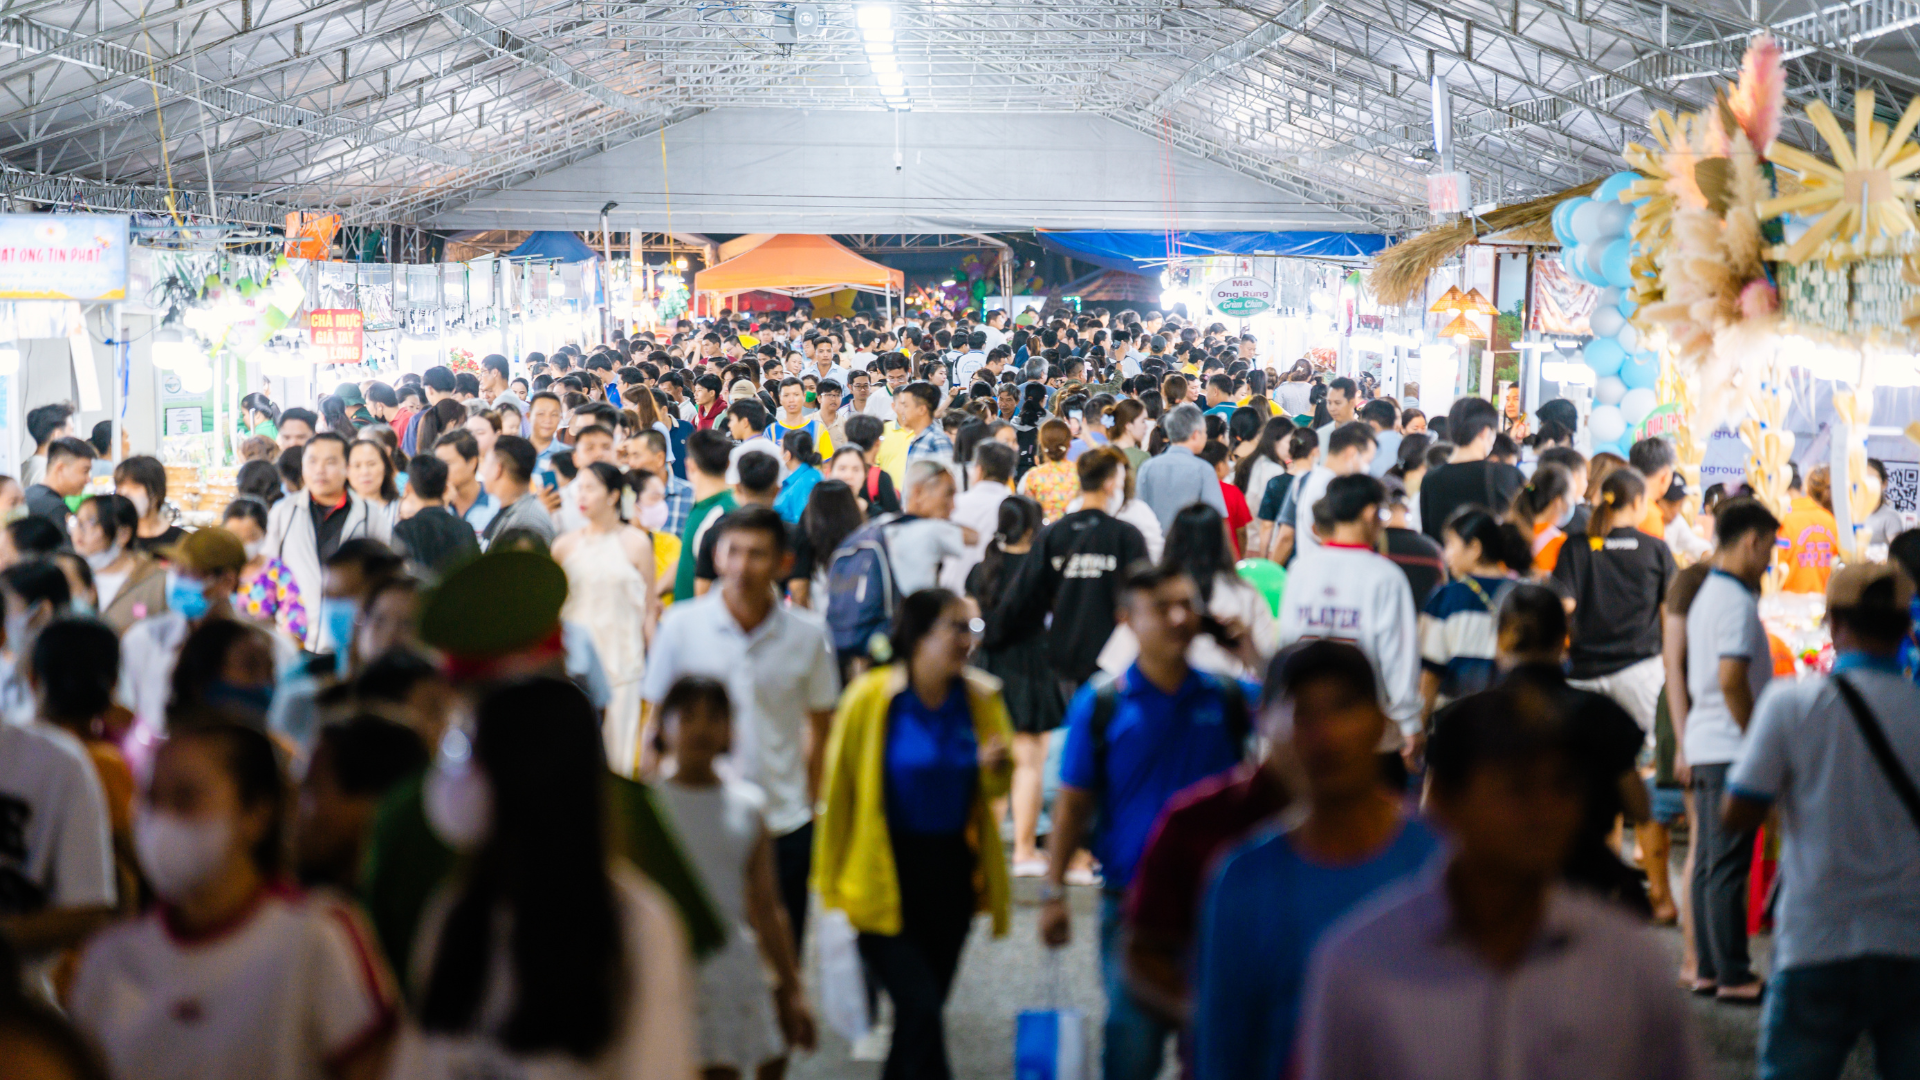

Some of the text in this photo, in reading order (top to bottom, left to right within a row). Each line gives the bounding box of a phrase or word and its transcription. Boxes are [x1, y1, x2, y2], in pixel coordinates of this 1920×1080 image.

[20, 248, 43, 263] ONG
[1217, 291, 1239, 299] Ong
[311, 310, 361, 330] CHẢ MỰC
[315, 329, 355, 344] GIÃ TAY
[330, 346, 360, 360] LONG
[1700, 465, 1746, 476] ugroup
